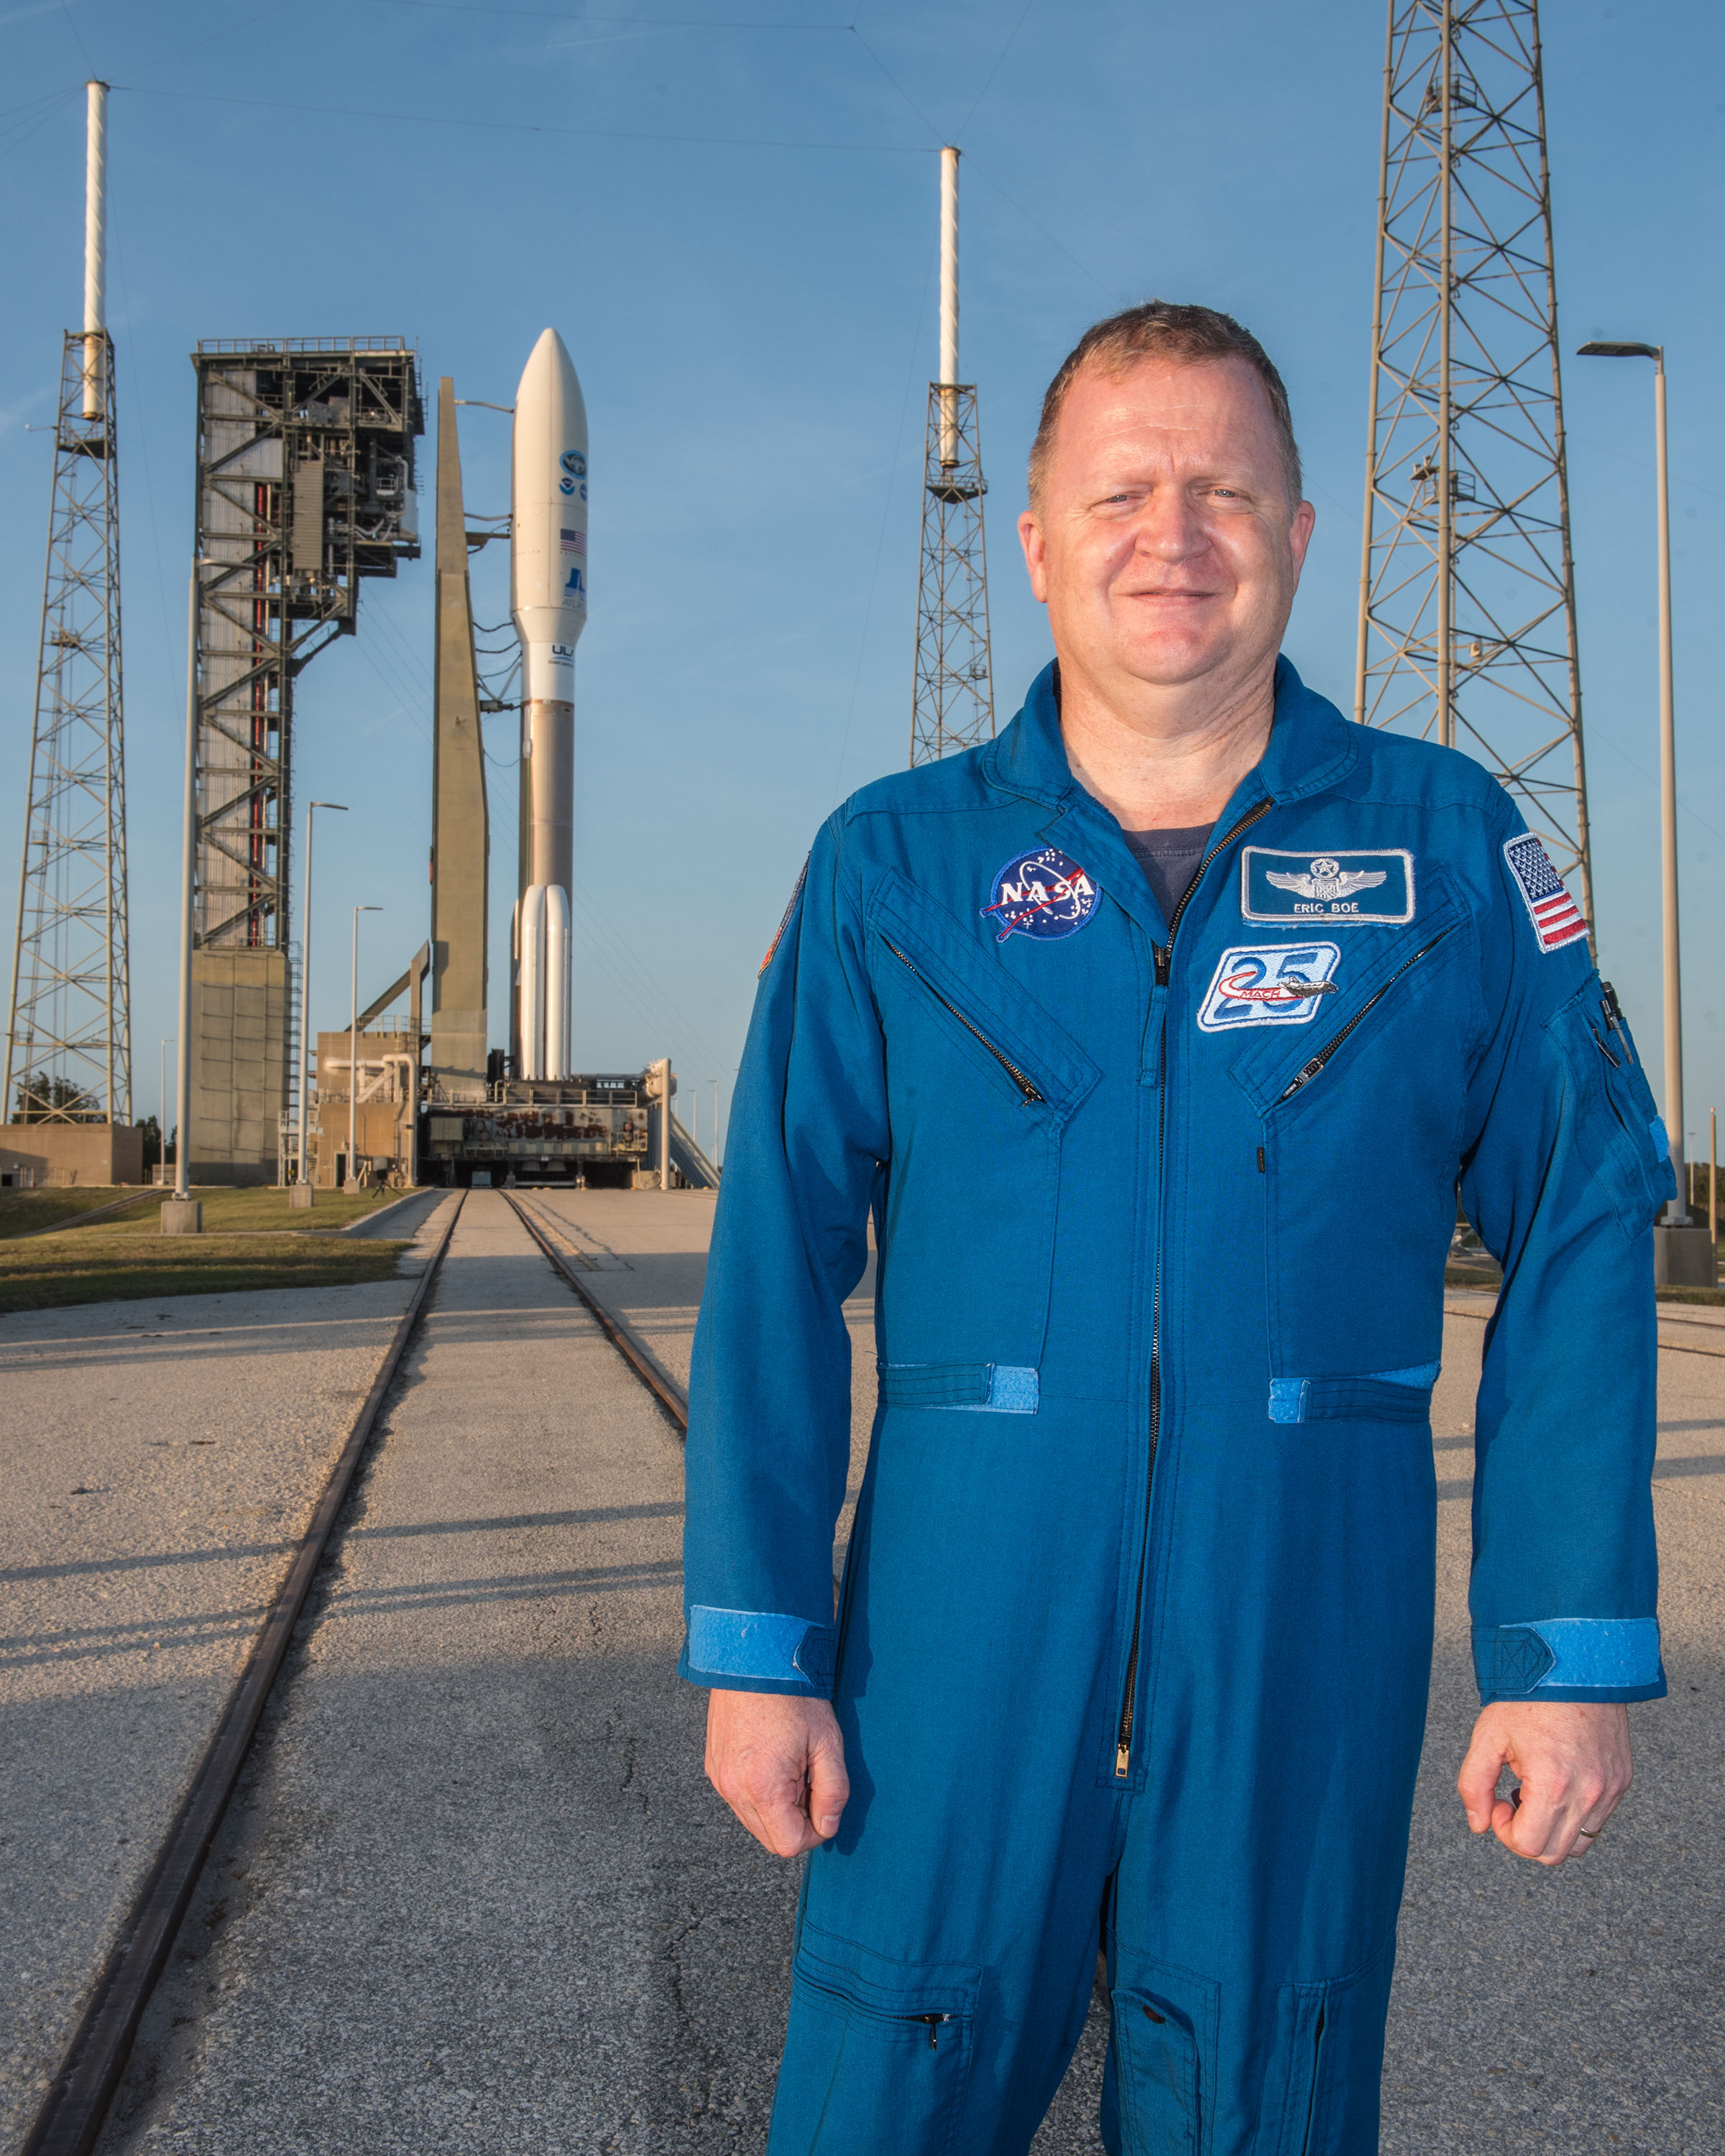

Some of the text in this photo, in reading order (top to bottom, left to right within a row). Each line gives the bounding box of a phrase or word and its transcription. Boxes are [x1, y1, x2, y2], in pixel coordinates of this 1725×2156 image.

[563, 597, 586, 610] ATLA
[1001, 875, 1095, 906] NASA
[1294, 903, 1359, 913] ERIC BOE
[1214, 952, 1318, 1020] 25
[1239, 990, 1281, 999] MACH
